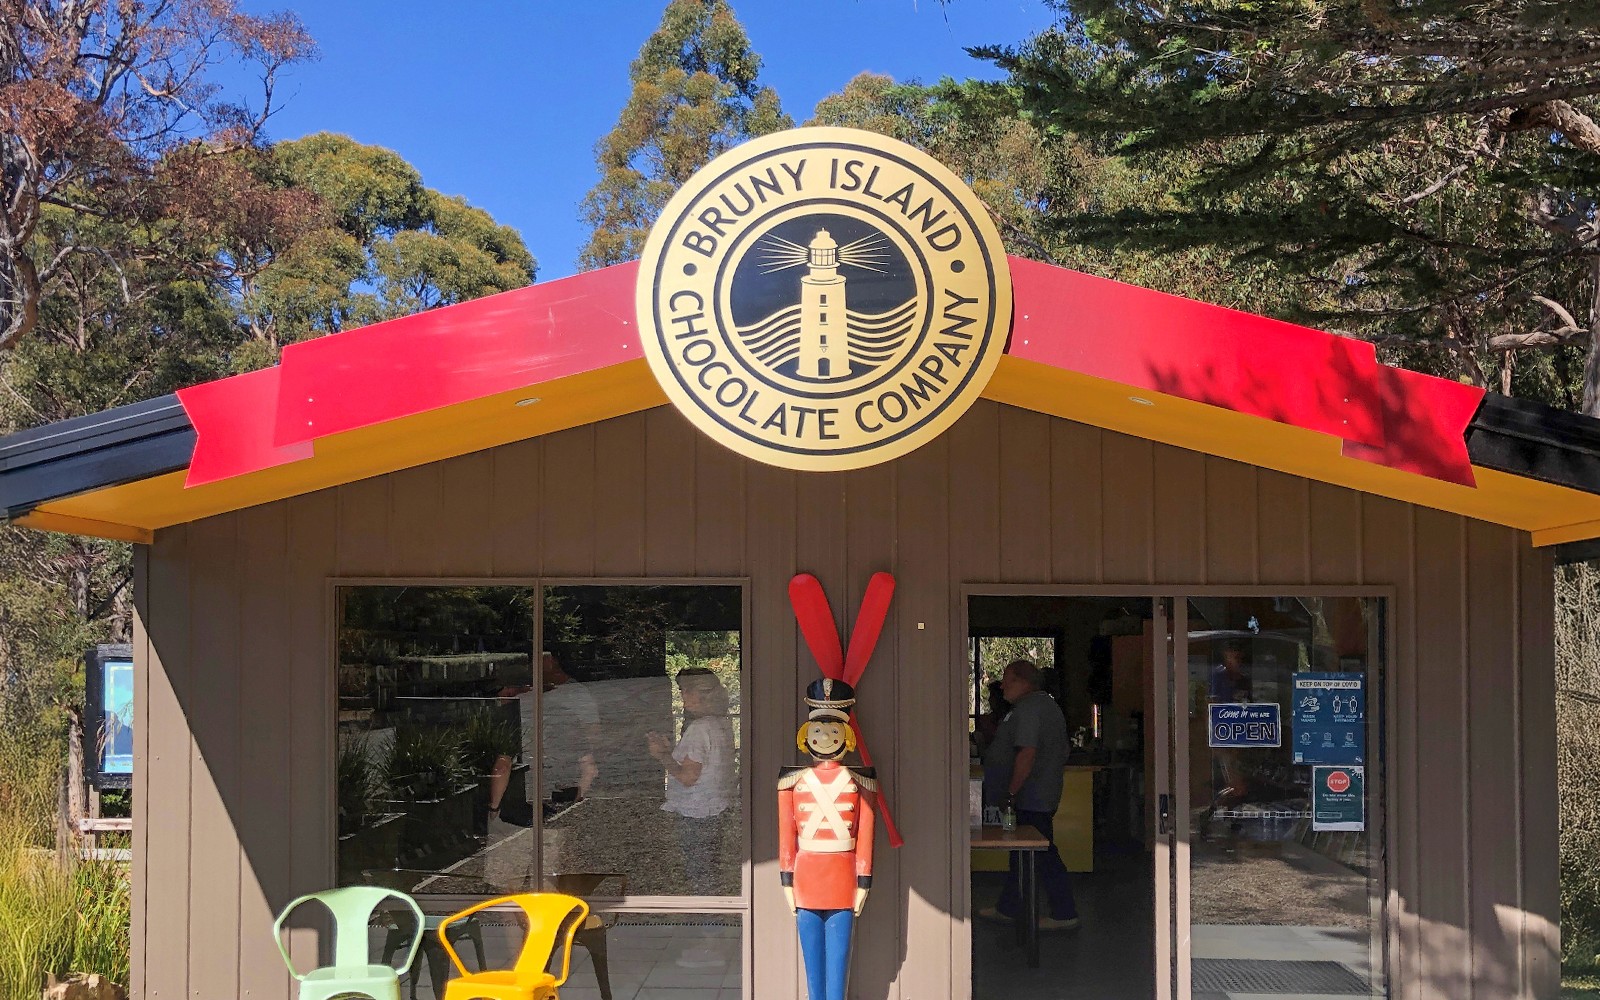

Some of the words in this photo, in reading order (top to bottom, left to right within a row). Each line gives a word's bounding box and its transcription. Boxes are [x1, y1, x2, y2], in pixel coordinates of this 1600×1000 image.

[682, 159, 807, 258] BRUNY
[829, 158, 962, 252] ISLAND
[669, 290, 840, 440] CHOCOLATE
[854, 288, 979, 433] COMPANY
[1214, 722, 1276, 741] OPEN
